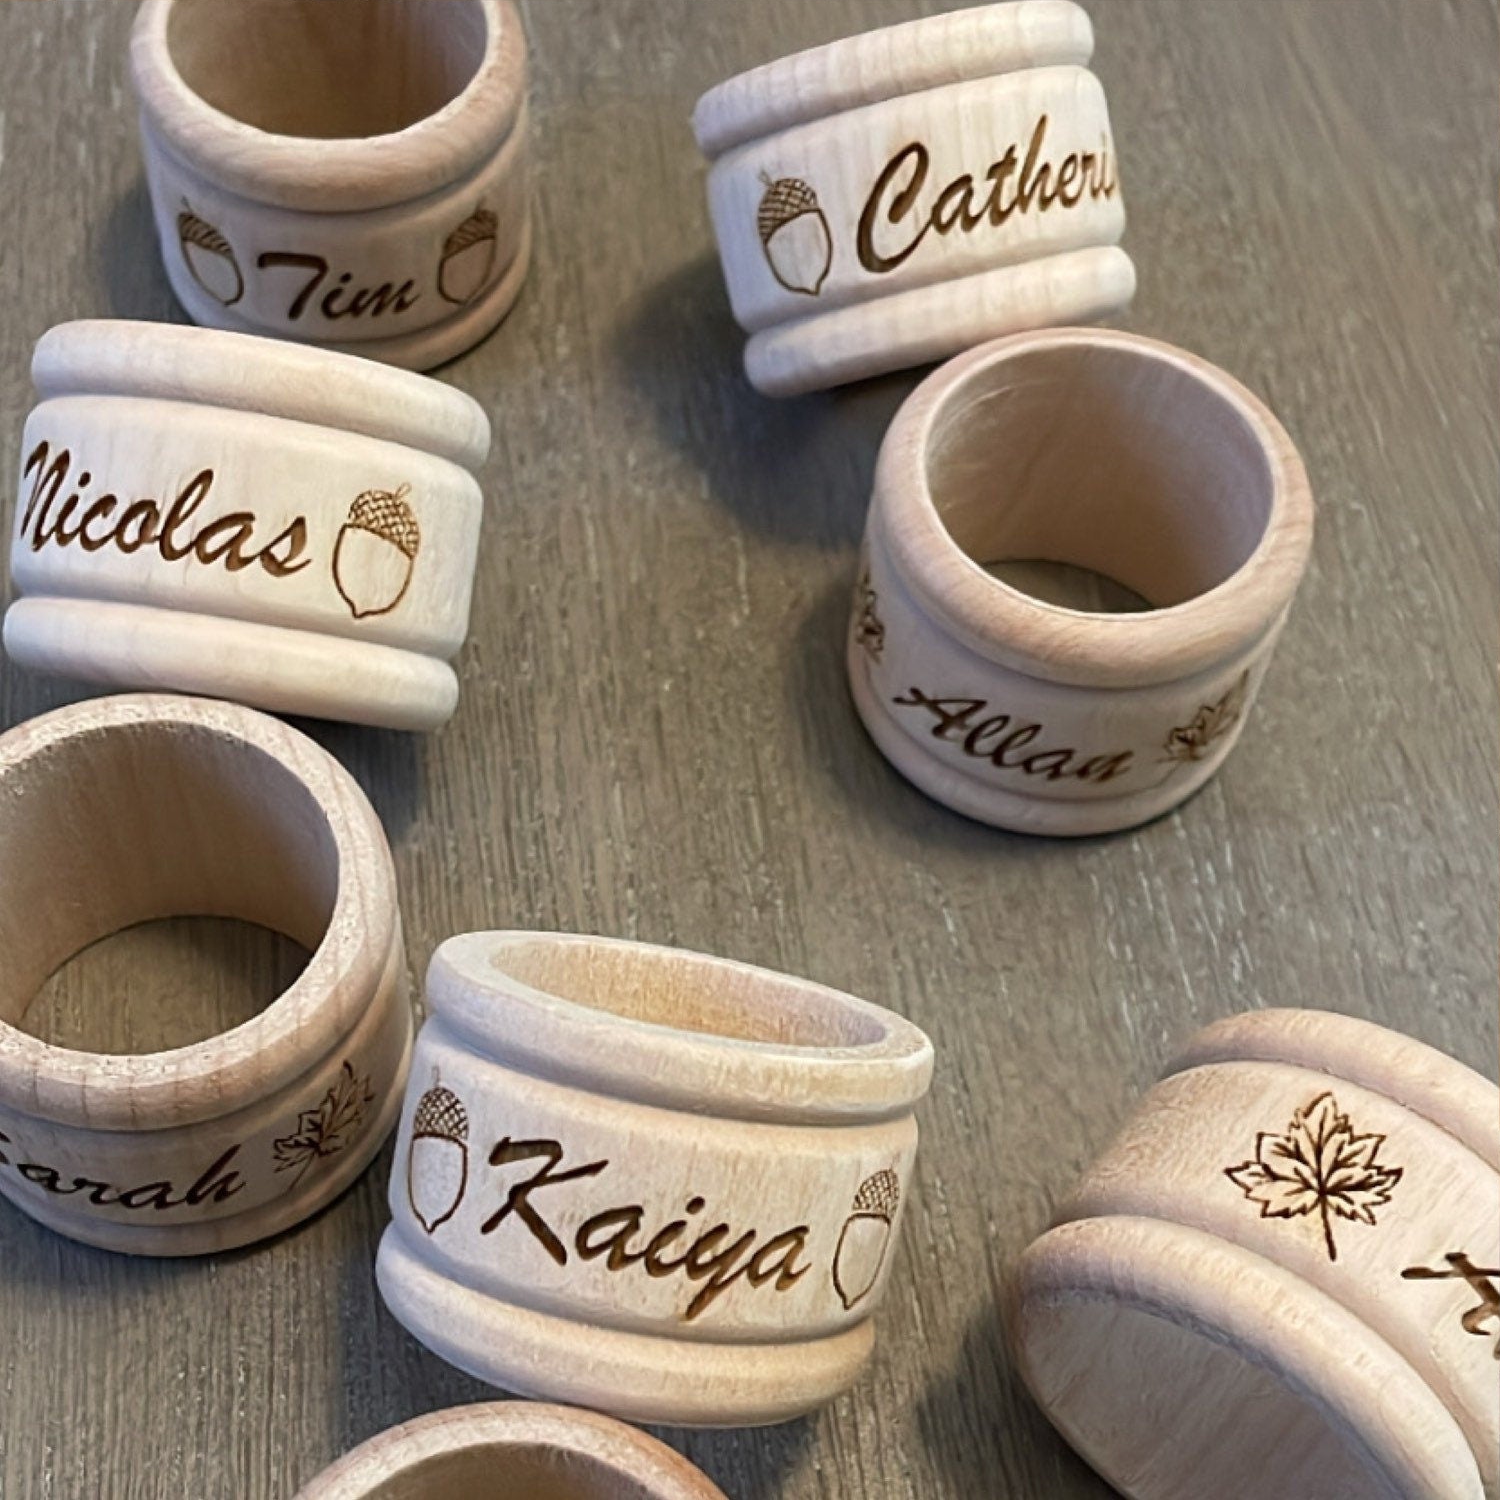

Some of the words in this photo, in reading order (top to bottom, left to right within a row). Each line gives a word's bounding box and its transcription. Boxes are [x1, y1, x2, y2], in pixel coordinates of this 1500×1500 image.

[257, 251, 421, 321] Tim
[20, 440, 312, 578] Nicolas
[892, 686, 1134, 784] Allan
[0, 1131, 247, 1211] arah
[480, 1136, 812, 1322] Kaiya
